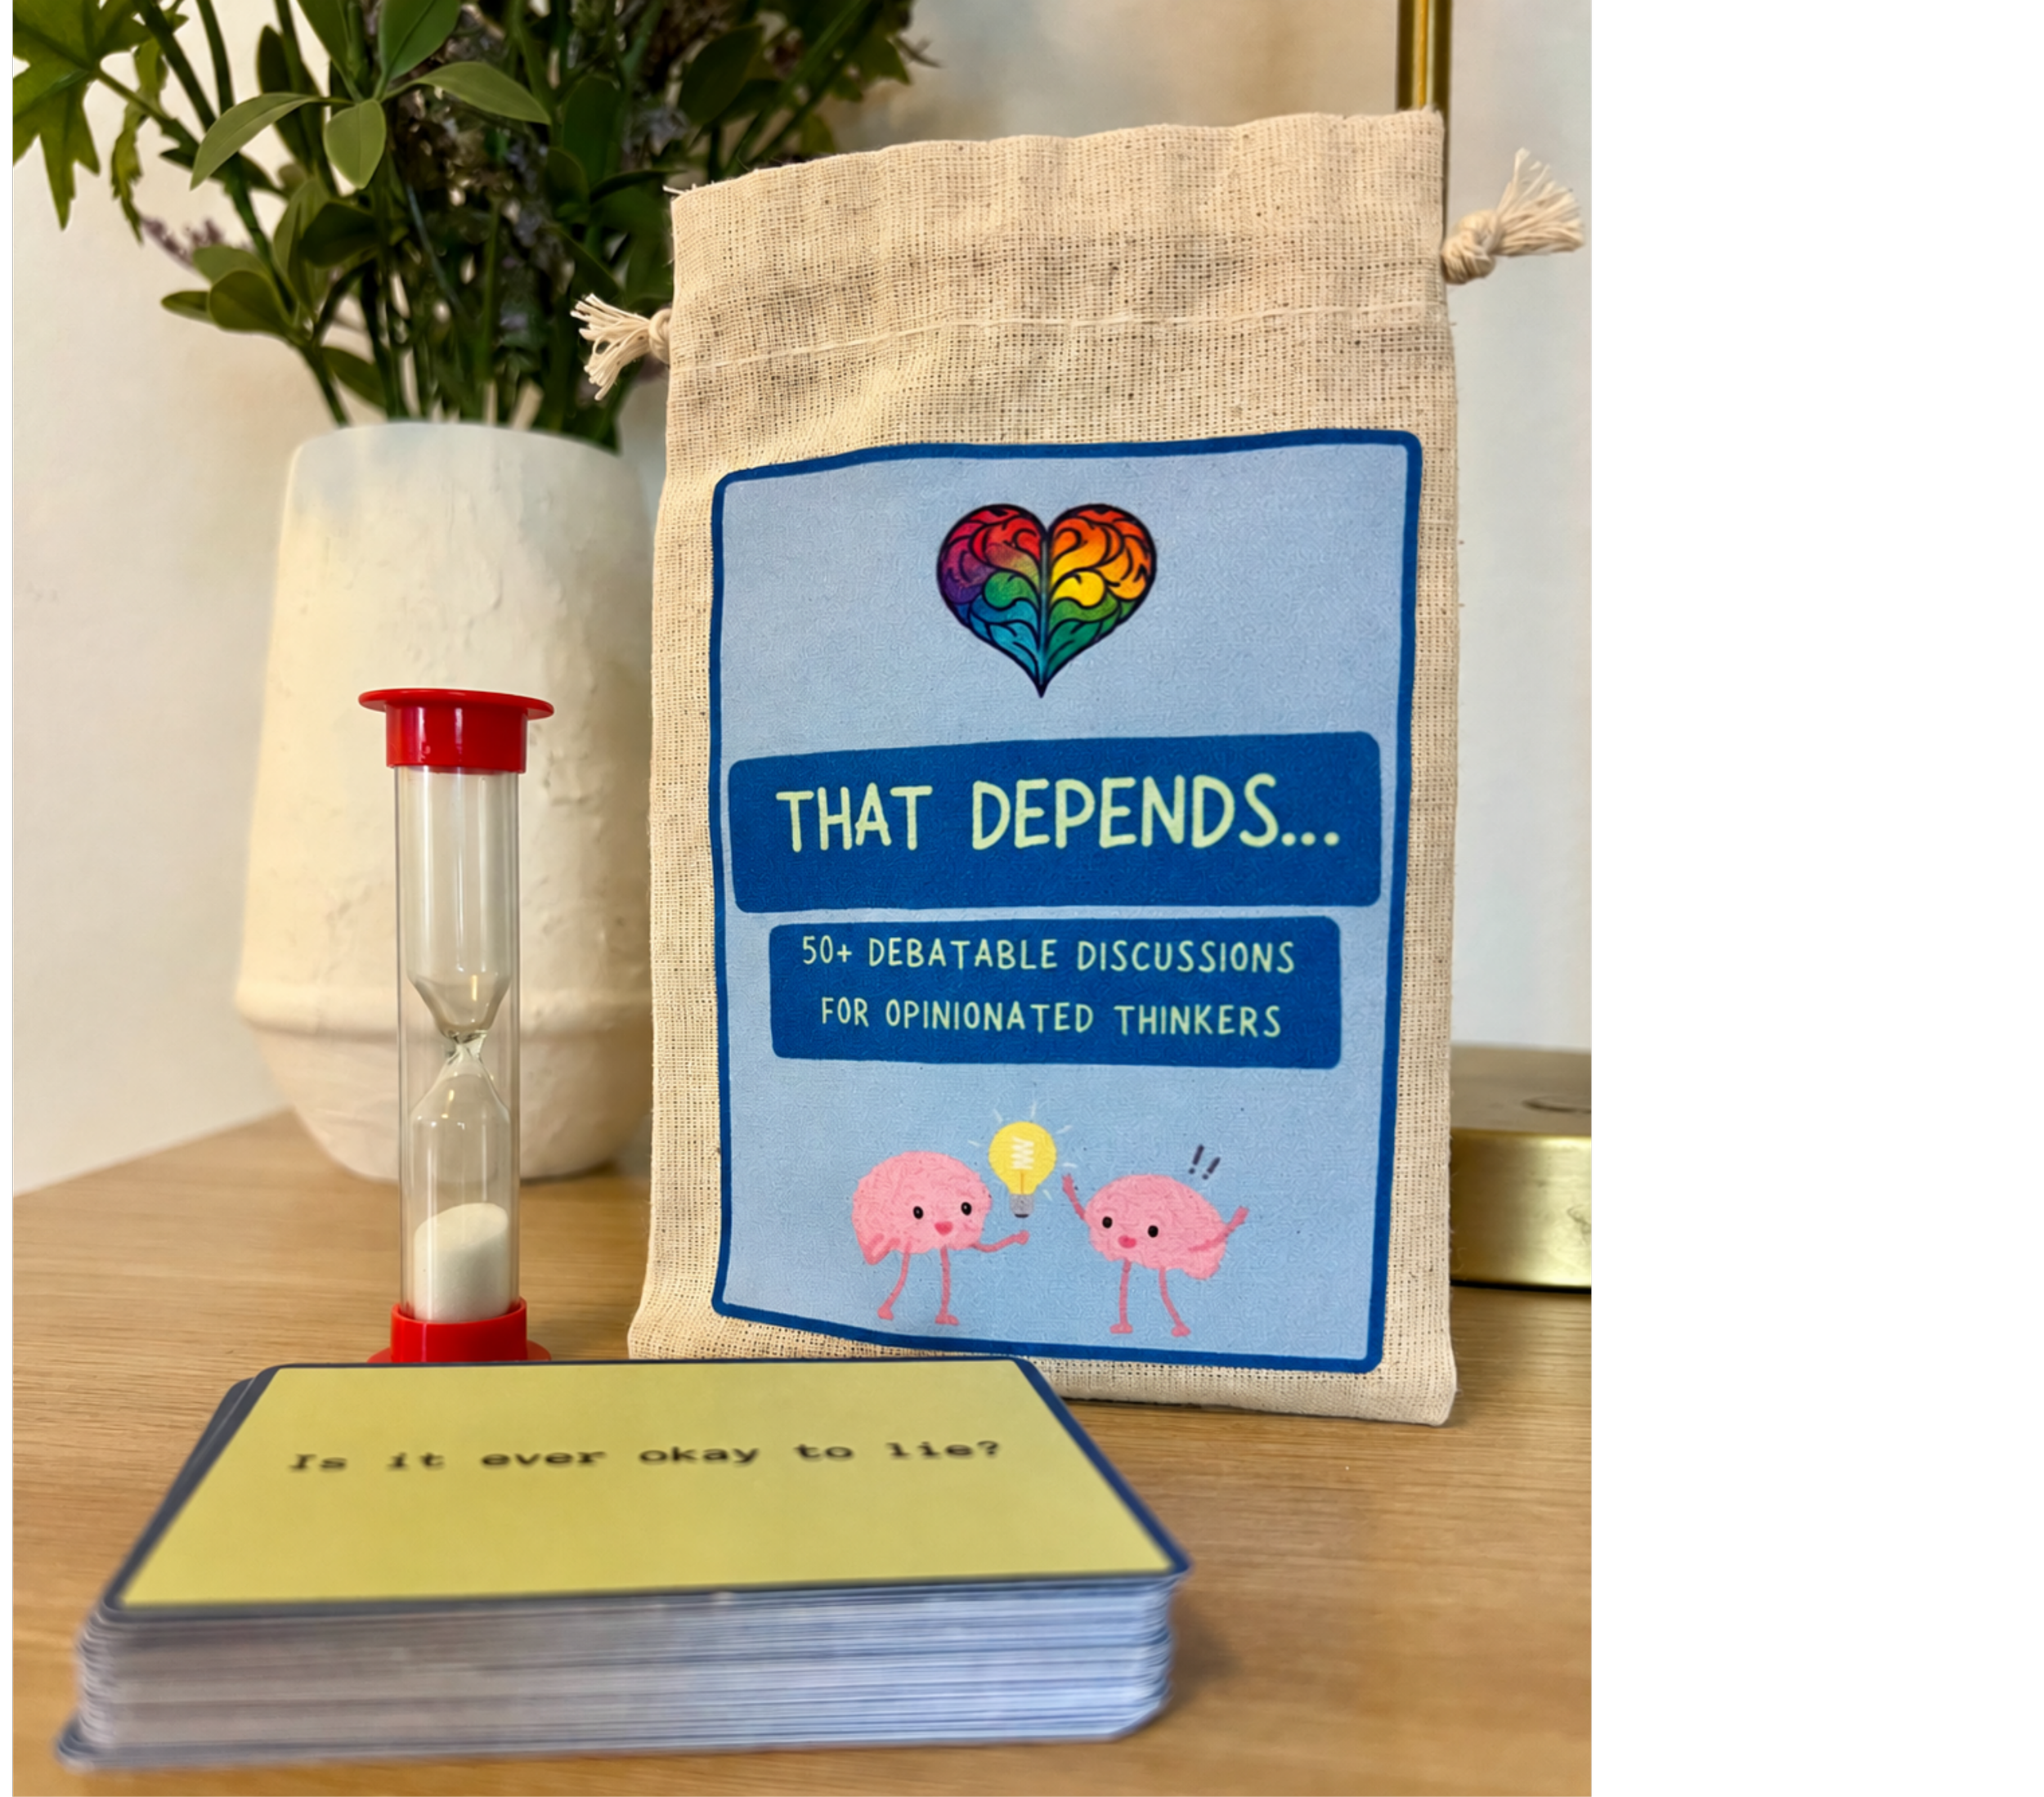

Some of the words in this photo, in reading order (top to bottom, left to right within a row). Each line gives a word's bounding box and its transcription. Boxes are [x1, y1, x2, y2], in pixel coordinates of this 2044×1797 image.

[776, 782, 933, 853] THAT
[972, 773, 1339, 850] DEPENDS...
[803, 934, 852, 965] 50+
[869, 937, 1057, 970] DEBATABLE
[1078, 940, 1293, 973] DISCUSSIONS
[822, 997, 869, 1027] FOR
[885, 999, 1093, 1033] OPINIONATED
[1114, 1005, 1280, 1037] THINKERS
[288, 1453, 347, 1472] Is
[388, 1452, 444, 1471] it
[480, 1451, 607, 1468] ever
[637, 1445, 760, 1467] okay
[794, 1444, 854, 1461] to
[886, 1440, 1000, 1459] lie?
